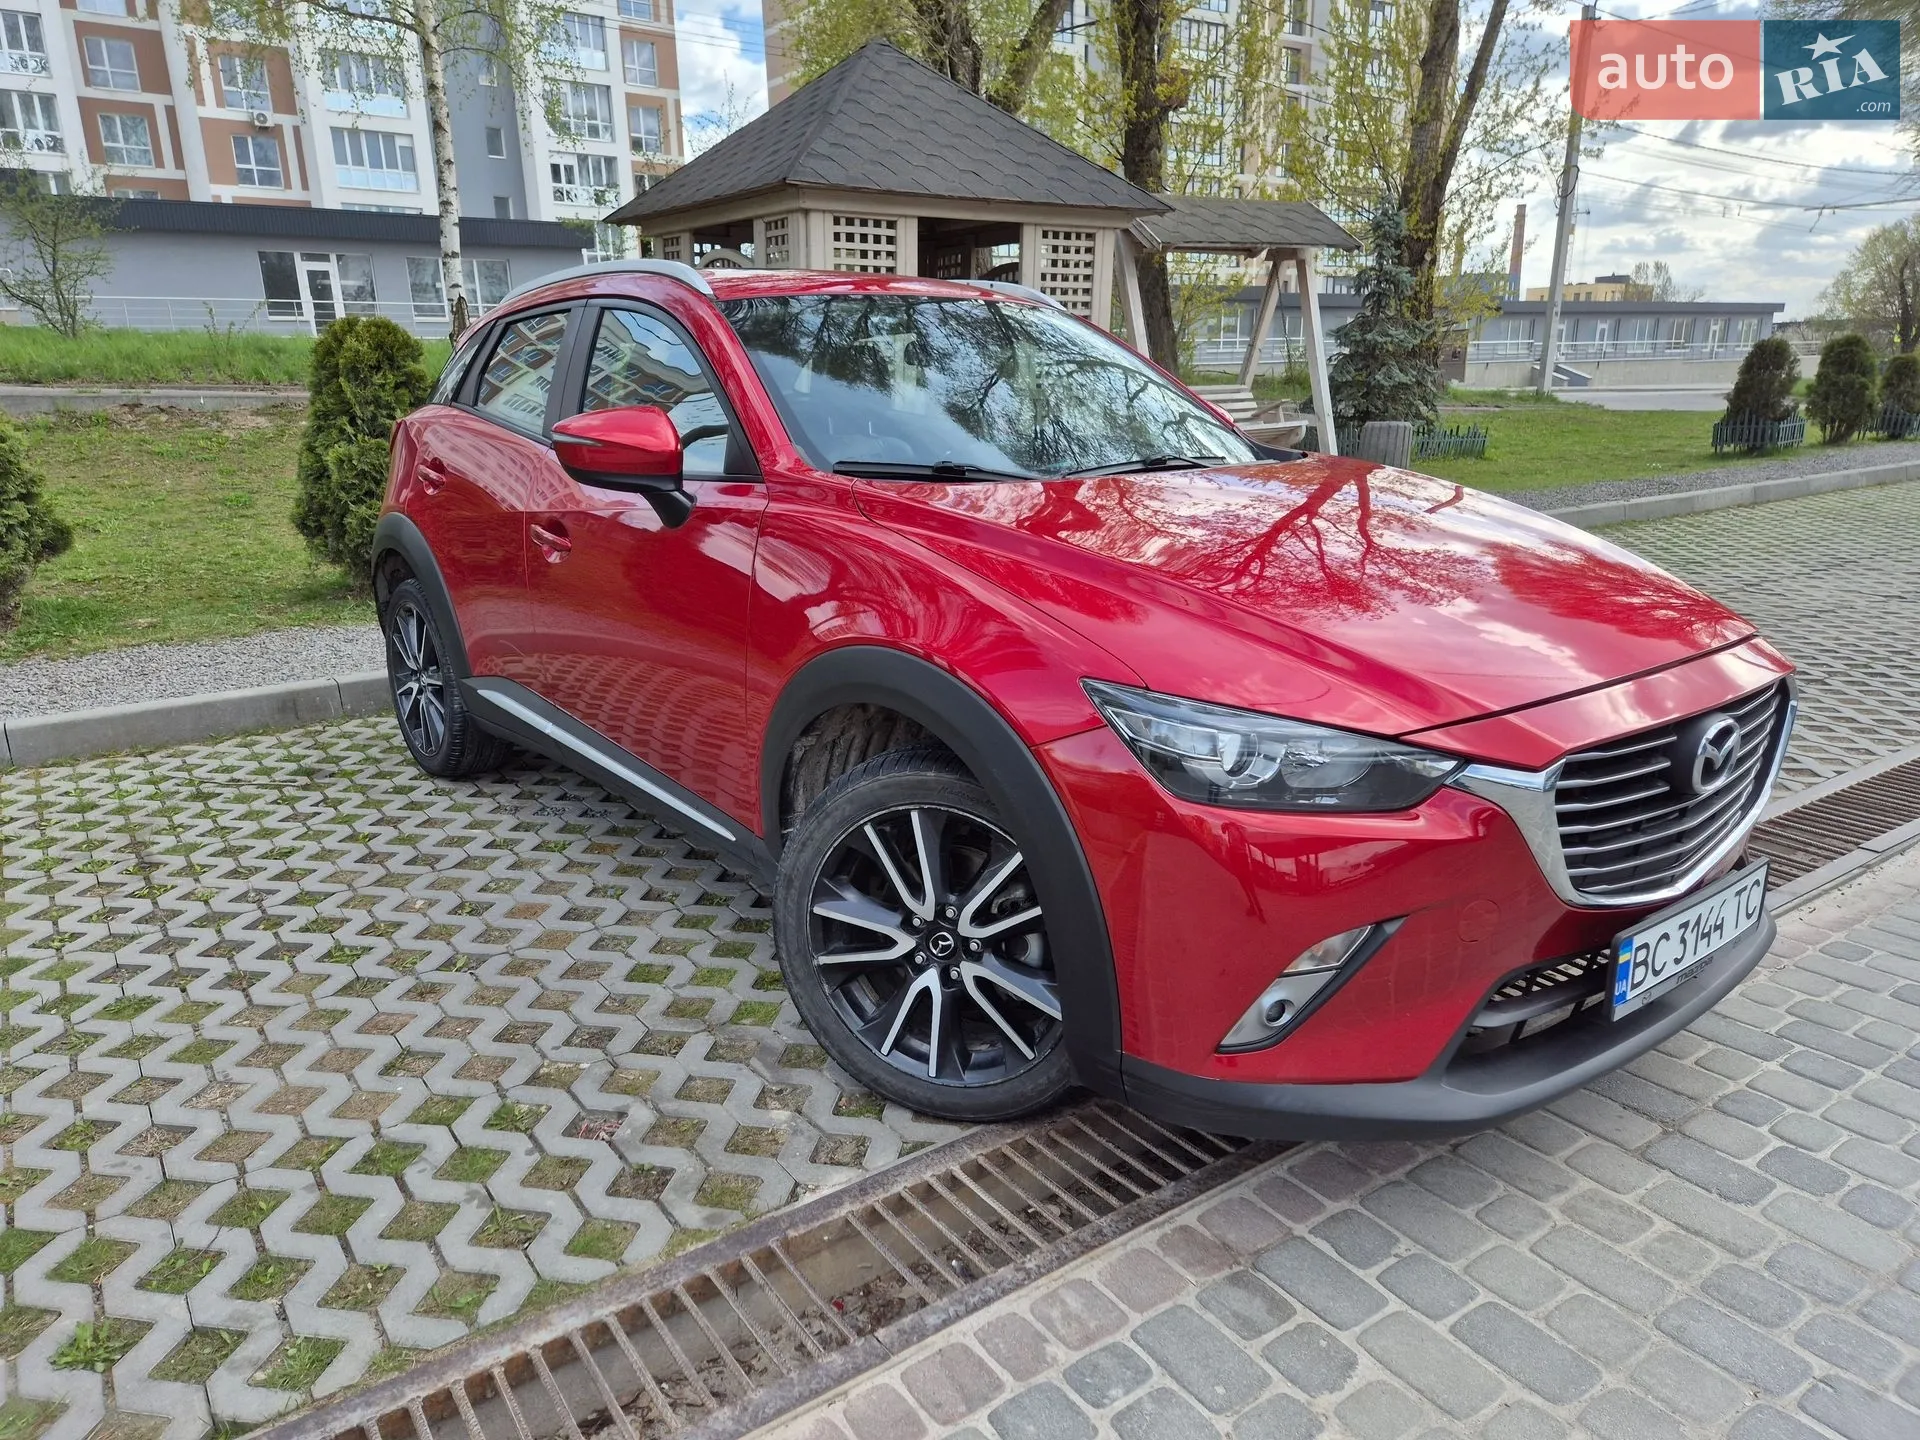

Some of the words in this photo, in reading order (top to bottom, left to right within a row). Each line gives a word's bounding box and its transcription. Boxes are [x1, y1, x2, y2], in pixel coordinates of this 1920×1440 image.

[1630, 932, 1671, 991] BC
[1673, 898, 1728, 966] 3144
[1734, 878, 1761, 930] TC
[1614, 979, 1628, 997] UA
